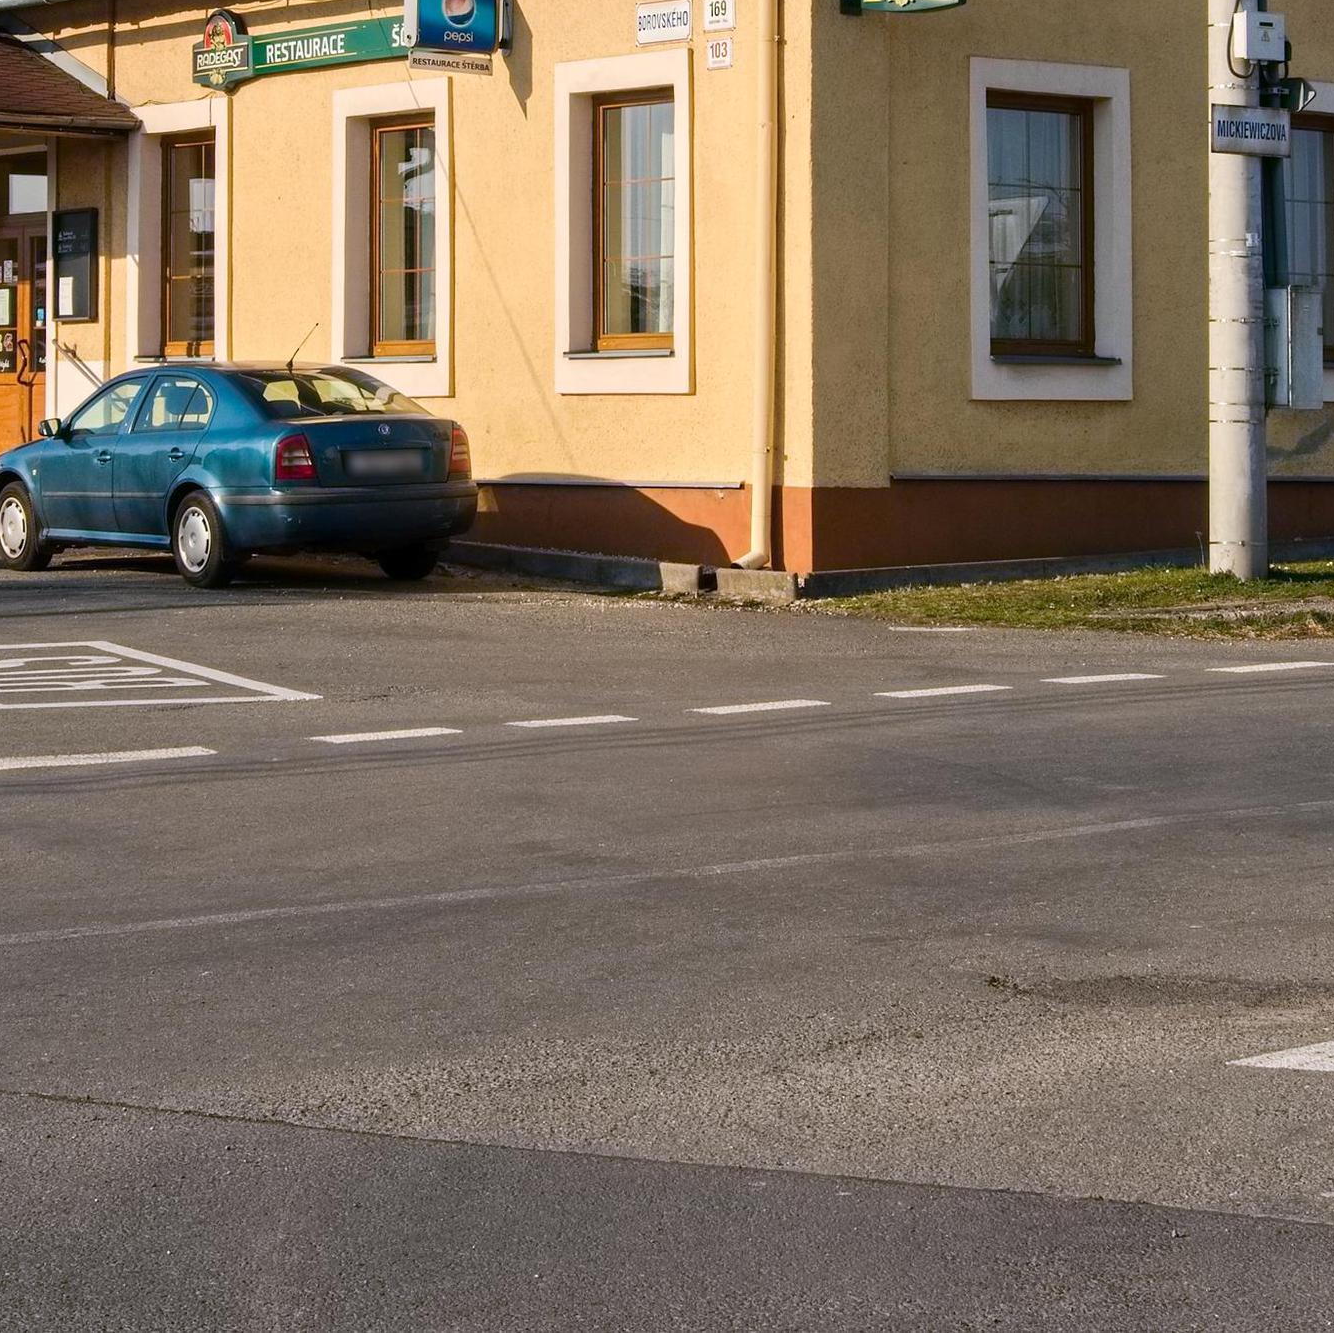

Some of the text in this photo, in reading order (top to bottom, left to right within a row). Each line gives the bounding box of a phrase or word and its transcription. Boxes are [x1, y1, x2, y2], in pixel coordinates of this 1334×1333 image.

[709, 0, 727, 17] 169
[443, 30, 474, 43] pepsi
[266, 34, 345, 64] RESTAURACE
[710, 42, 728, 59] 103
[196, 48, 244, 70] RADEGAST
[412, 57, 490, 72] RESTAURACE ŠTĚRBA
[1217, 120, 1287, 142] MICKIEWICZOVA
